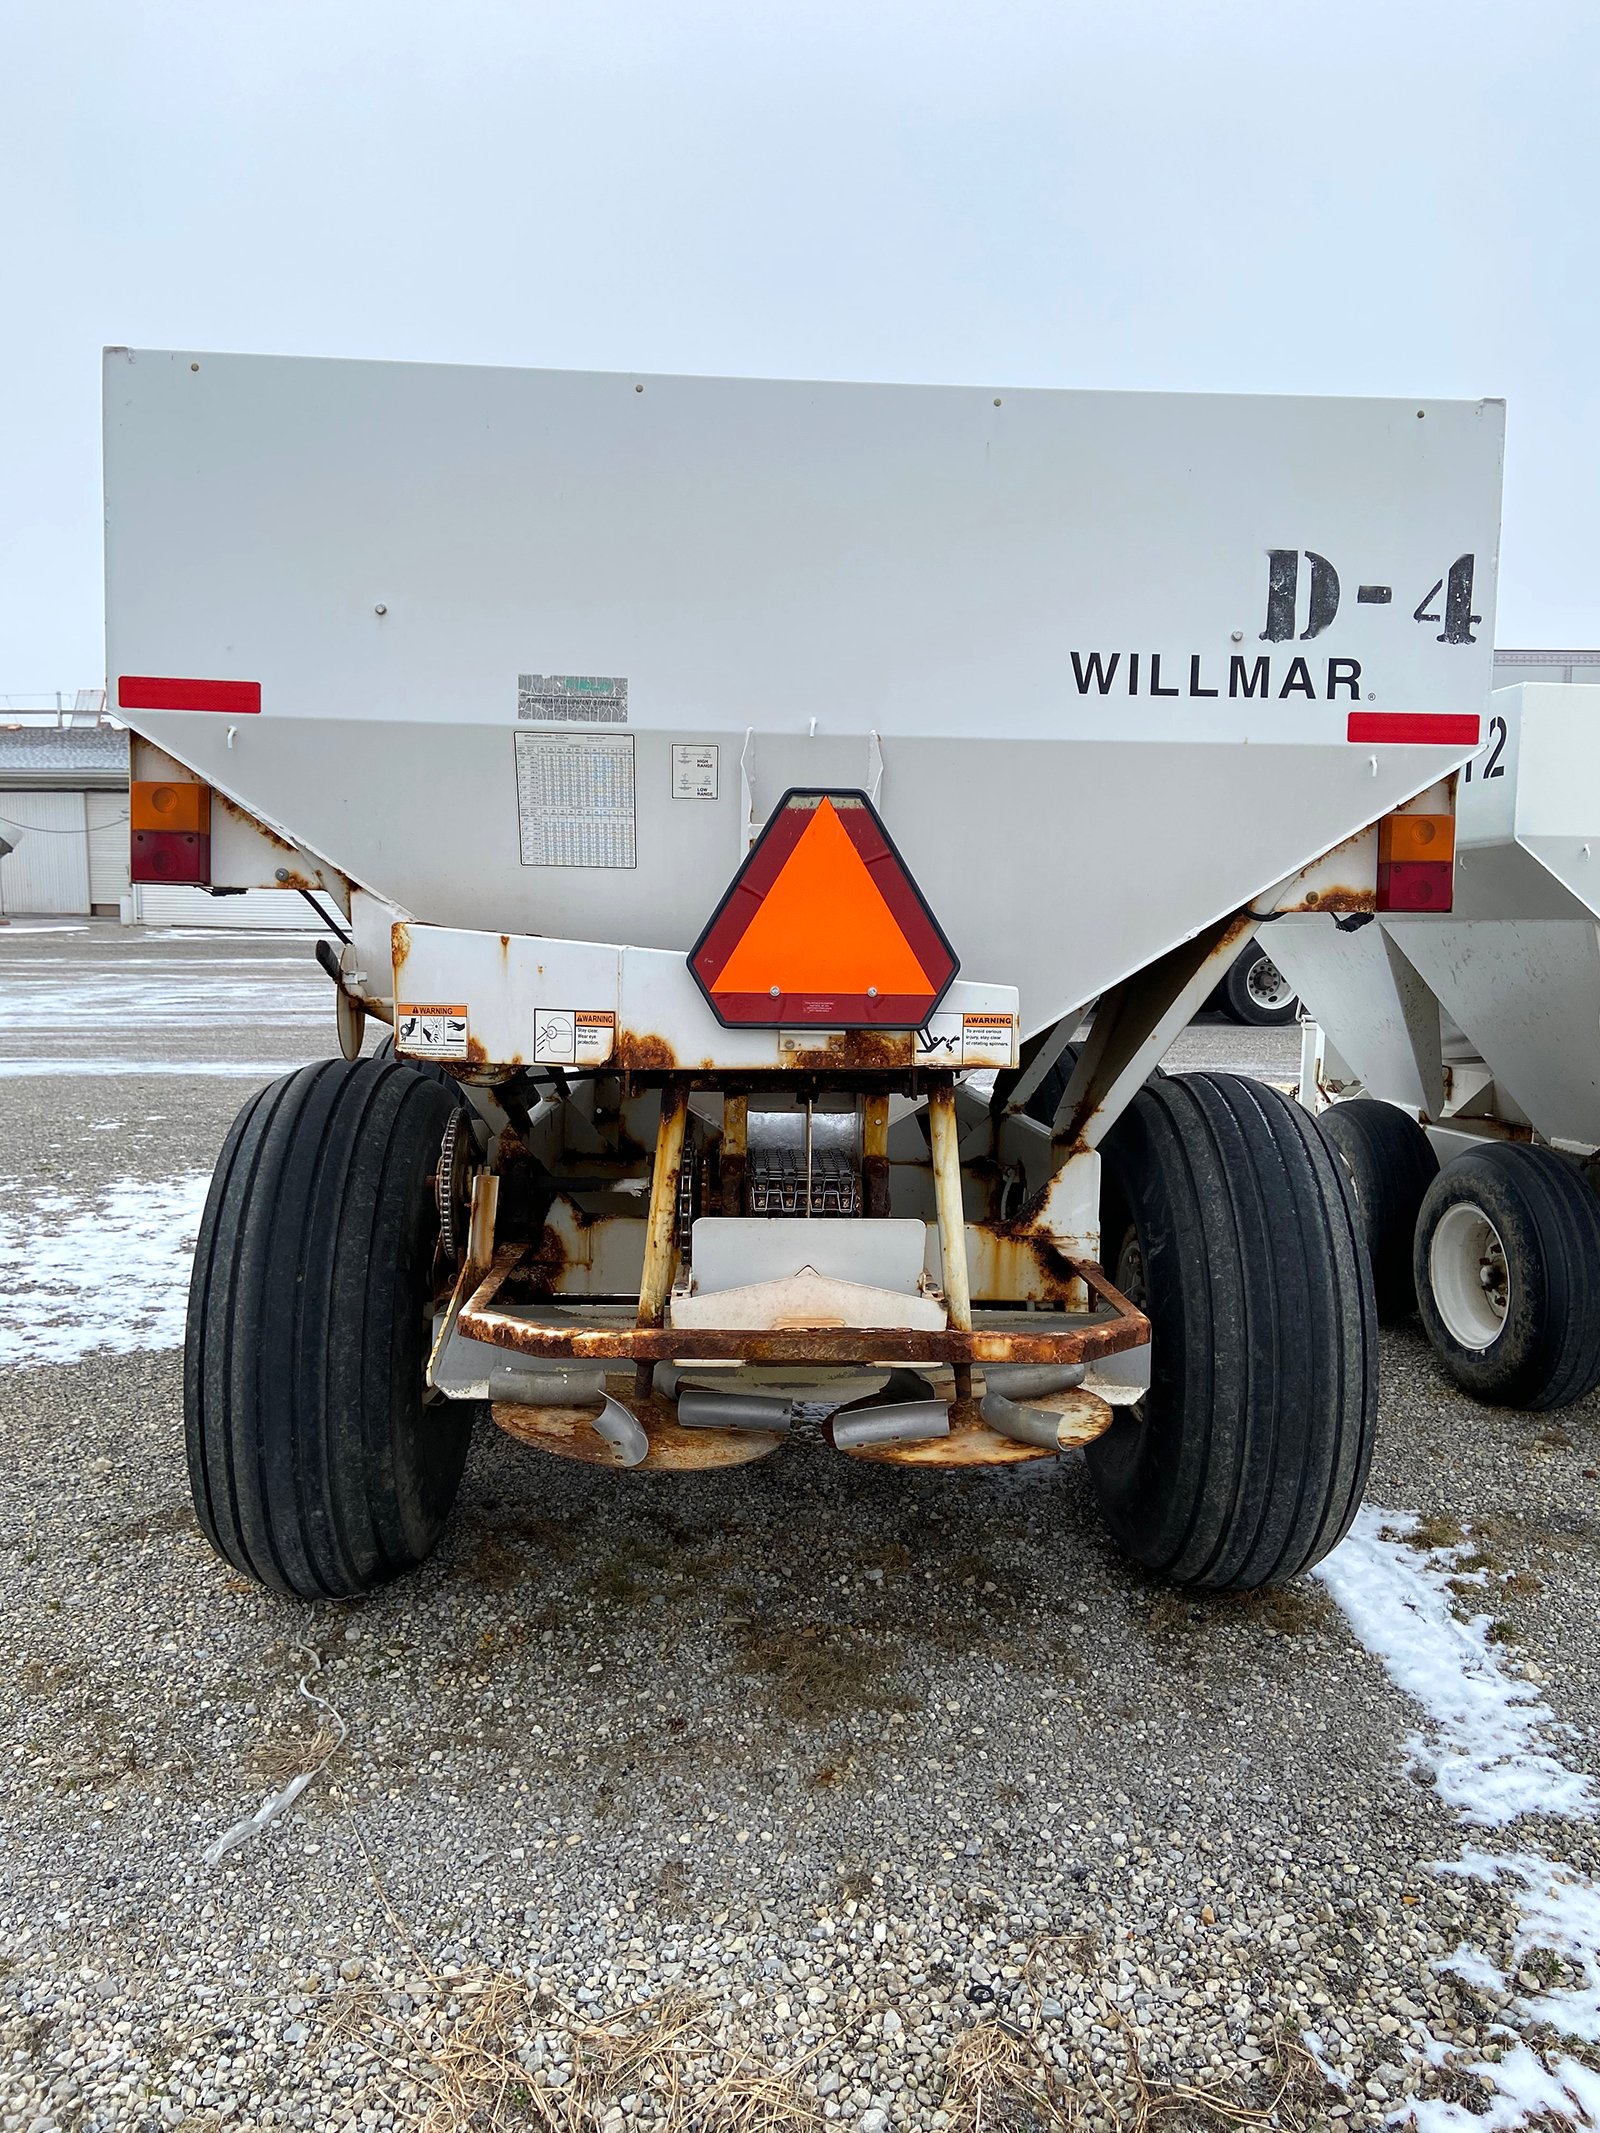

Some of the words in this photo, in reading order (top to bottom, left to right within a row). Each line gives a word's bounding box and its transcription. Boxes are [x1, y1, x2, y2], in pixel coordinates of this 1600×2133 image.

[1069, 651, 1361, 701] WILLMAR
[420, 1007, 453, 1015] WARNING
[582, 1015, 613, 1024] WARNING
[971, 1017, 1012, 1025] WARNING
